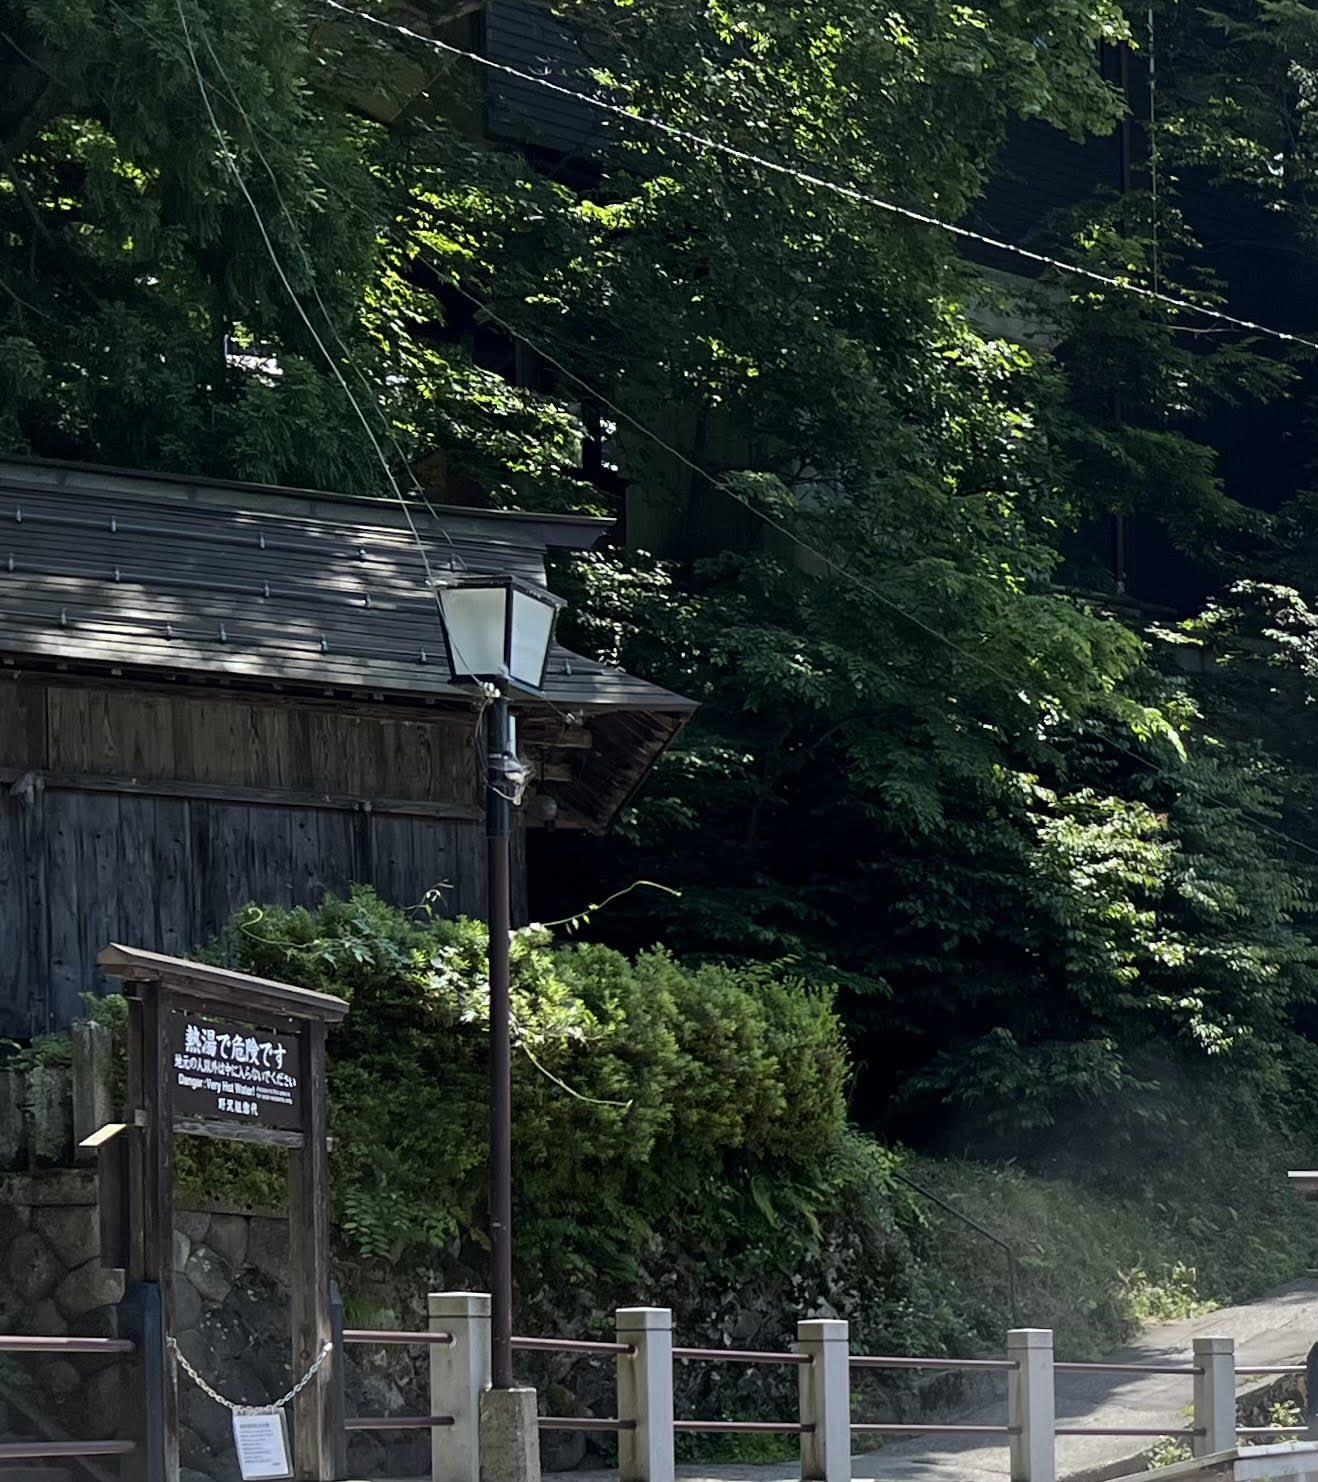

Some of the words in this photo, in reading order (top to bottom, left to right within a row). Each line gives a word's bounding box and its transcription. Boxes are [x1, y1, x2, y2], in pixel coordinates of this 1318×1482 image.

[185, 1024, 287, 1070] 熱湯で危険です
[174, 1053, 297, 1088] 地元の人以外は中に入らないでください
[178, 1073, 203, 1090] Danger
[221, 1080, 235, 1093] Hot
[235, 1082, 255, 1096] Water!
